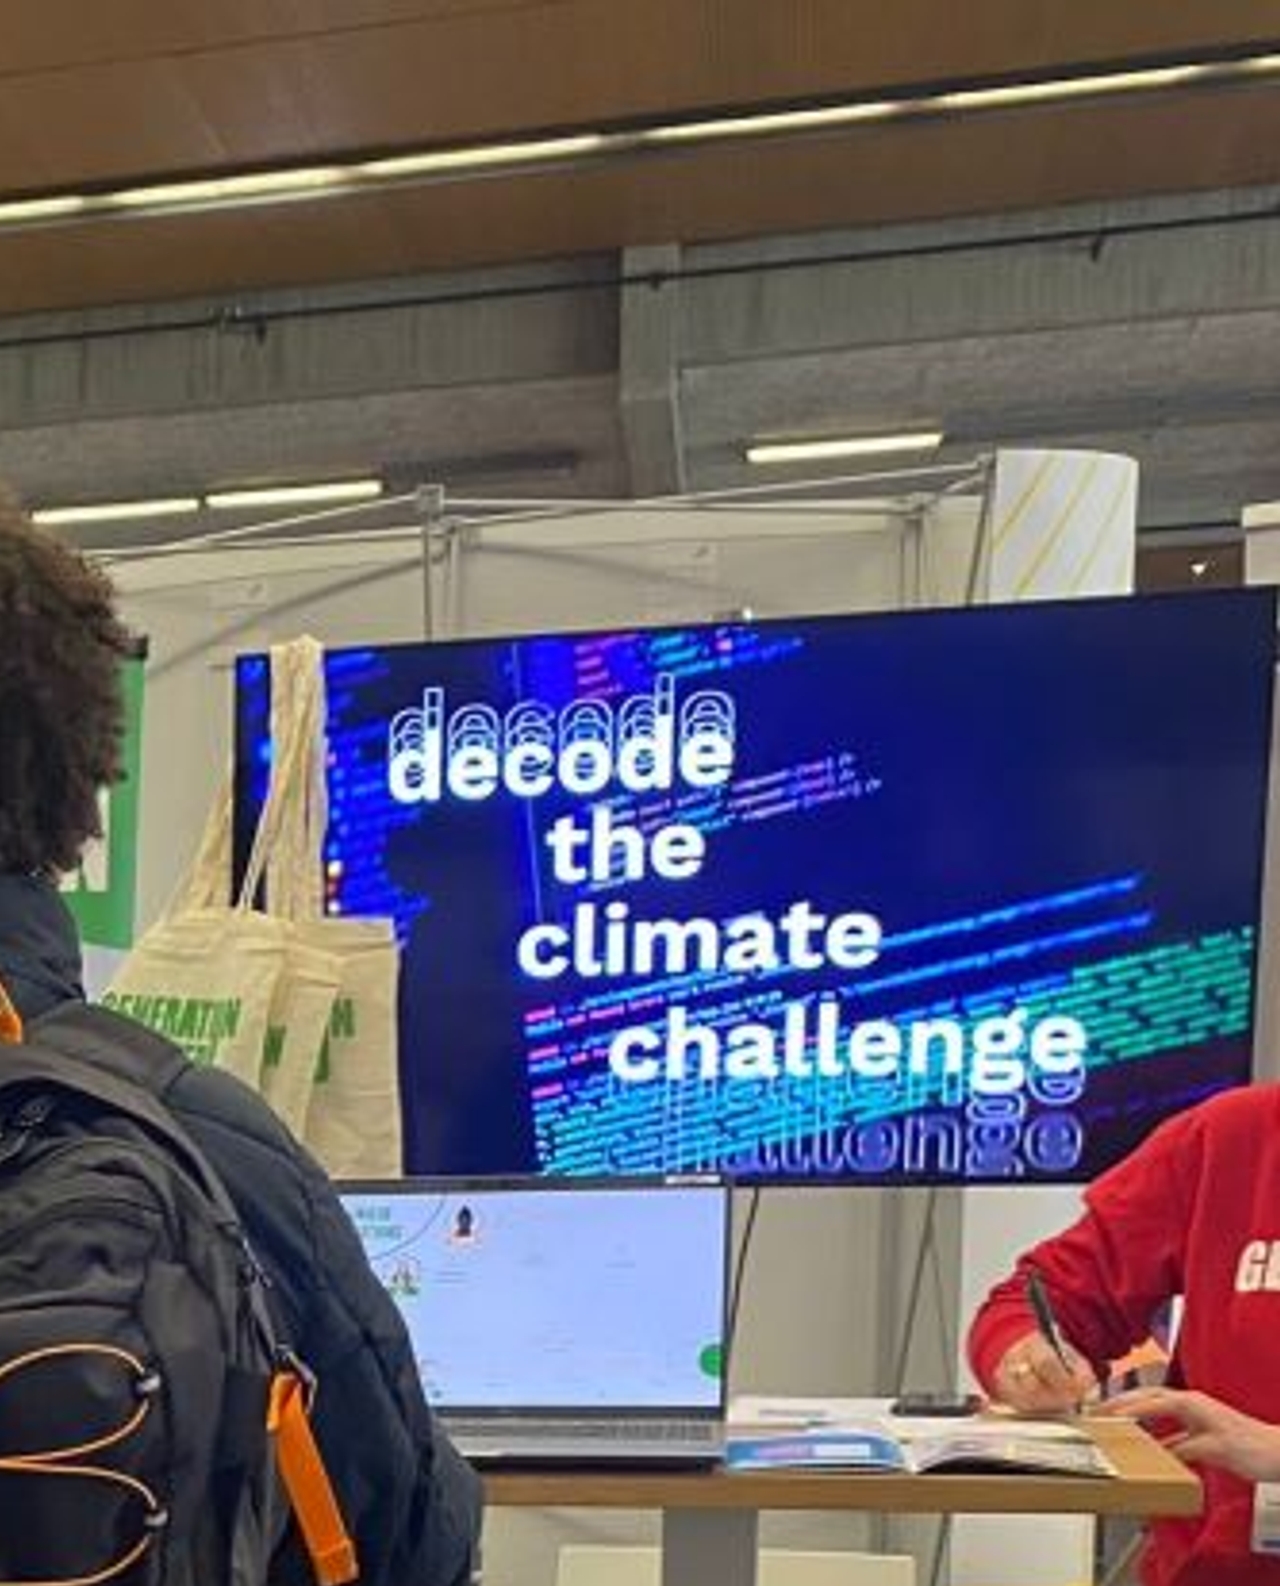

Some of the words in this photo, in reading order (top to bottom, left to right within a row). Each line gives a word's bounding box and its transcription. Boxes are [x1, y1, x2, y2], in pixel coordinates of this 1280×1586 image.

[389, 704, 735, 802] decode
[545, 805, 706, 886] the
[516, 901, 885, 980] climate
[606, 1002, 1089, 1095] challenge
